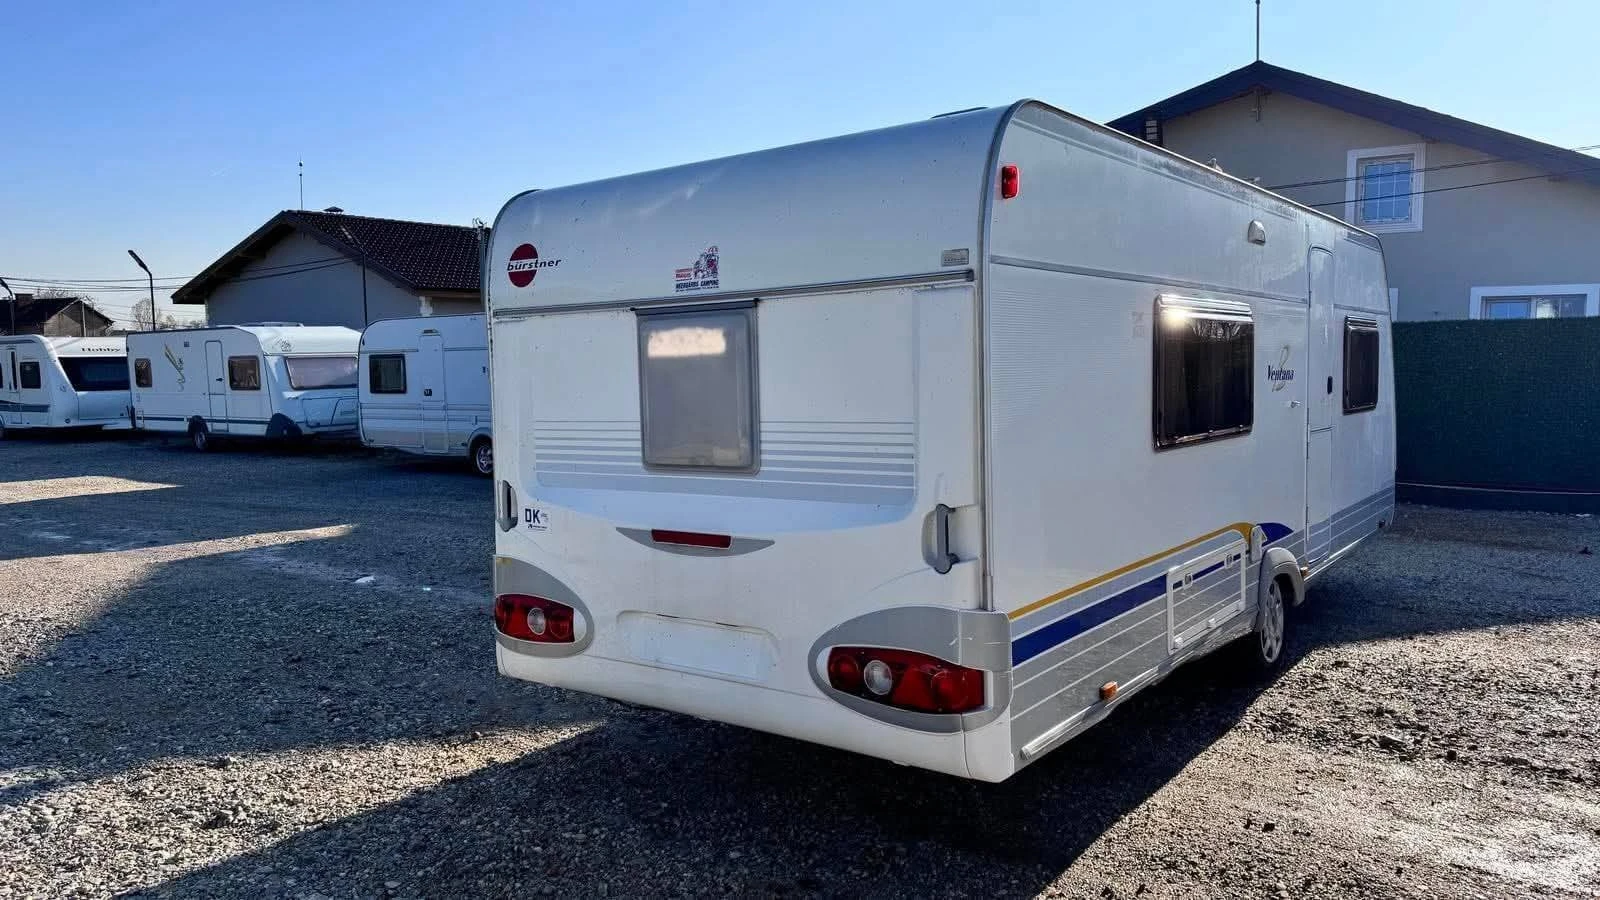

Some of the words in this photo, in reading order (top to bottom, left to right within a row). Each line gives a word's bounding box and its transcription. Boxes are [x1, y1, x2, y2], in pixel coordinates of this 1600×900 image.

[507, 259, 562, 271] bürstner
[1267, 365, 1294, 381] Ventana
[525, 508, 540, 524] DK
